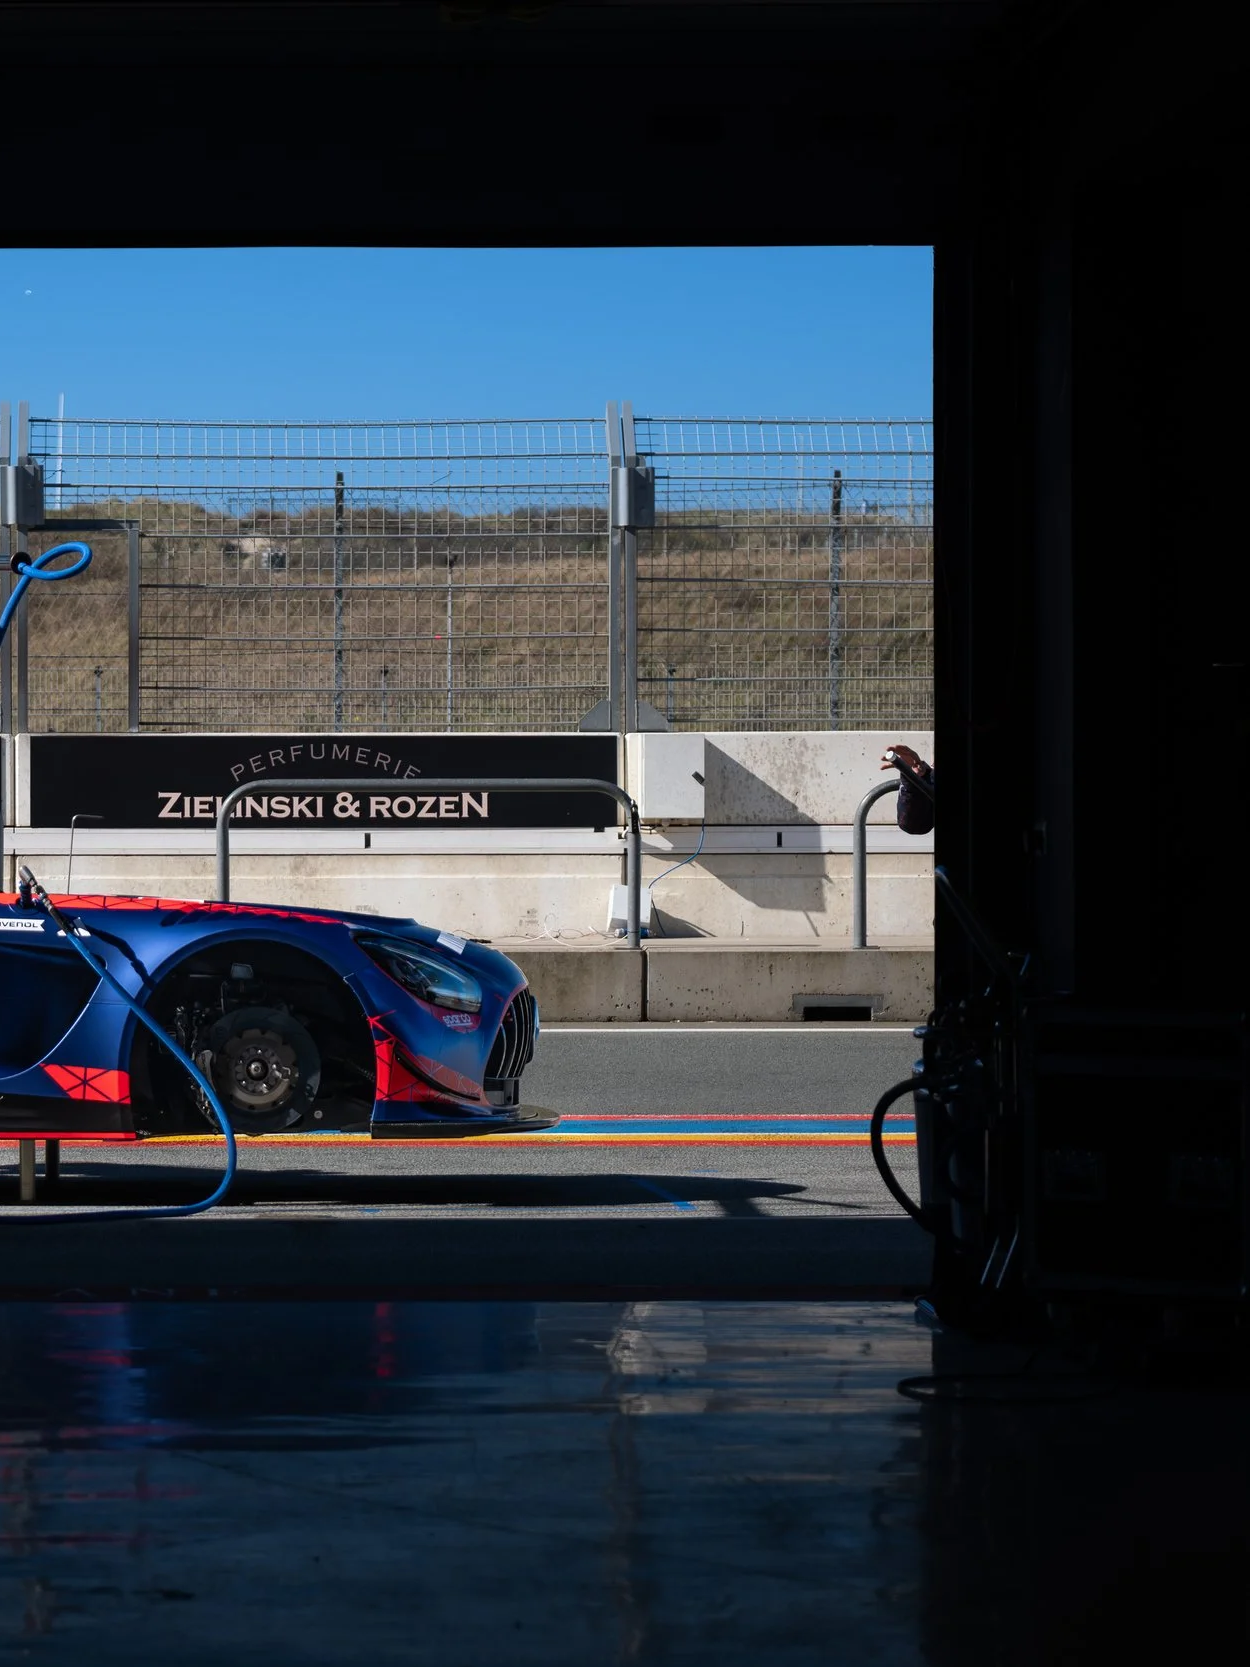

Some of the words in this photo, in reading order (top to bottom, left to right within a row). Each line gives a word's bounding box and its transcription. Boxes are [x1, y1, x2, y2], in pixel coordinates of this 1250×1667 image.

[229, 743, 422, 782] PERFUMERIE
[333, 791, 360, 818] &
[369, 792, 489, 818] ROZEN
